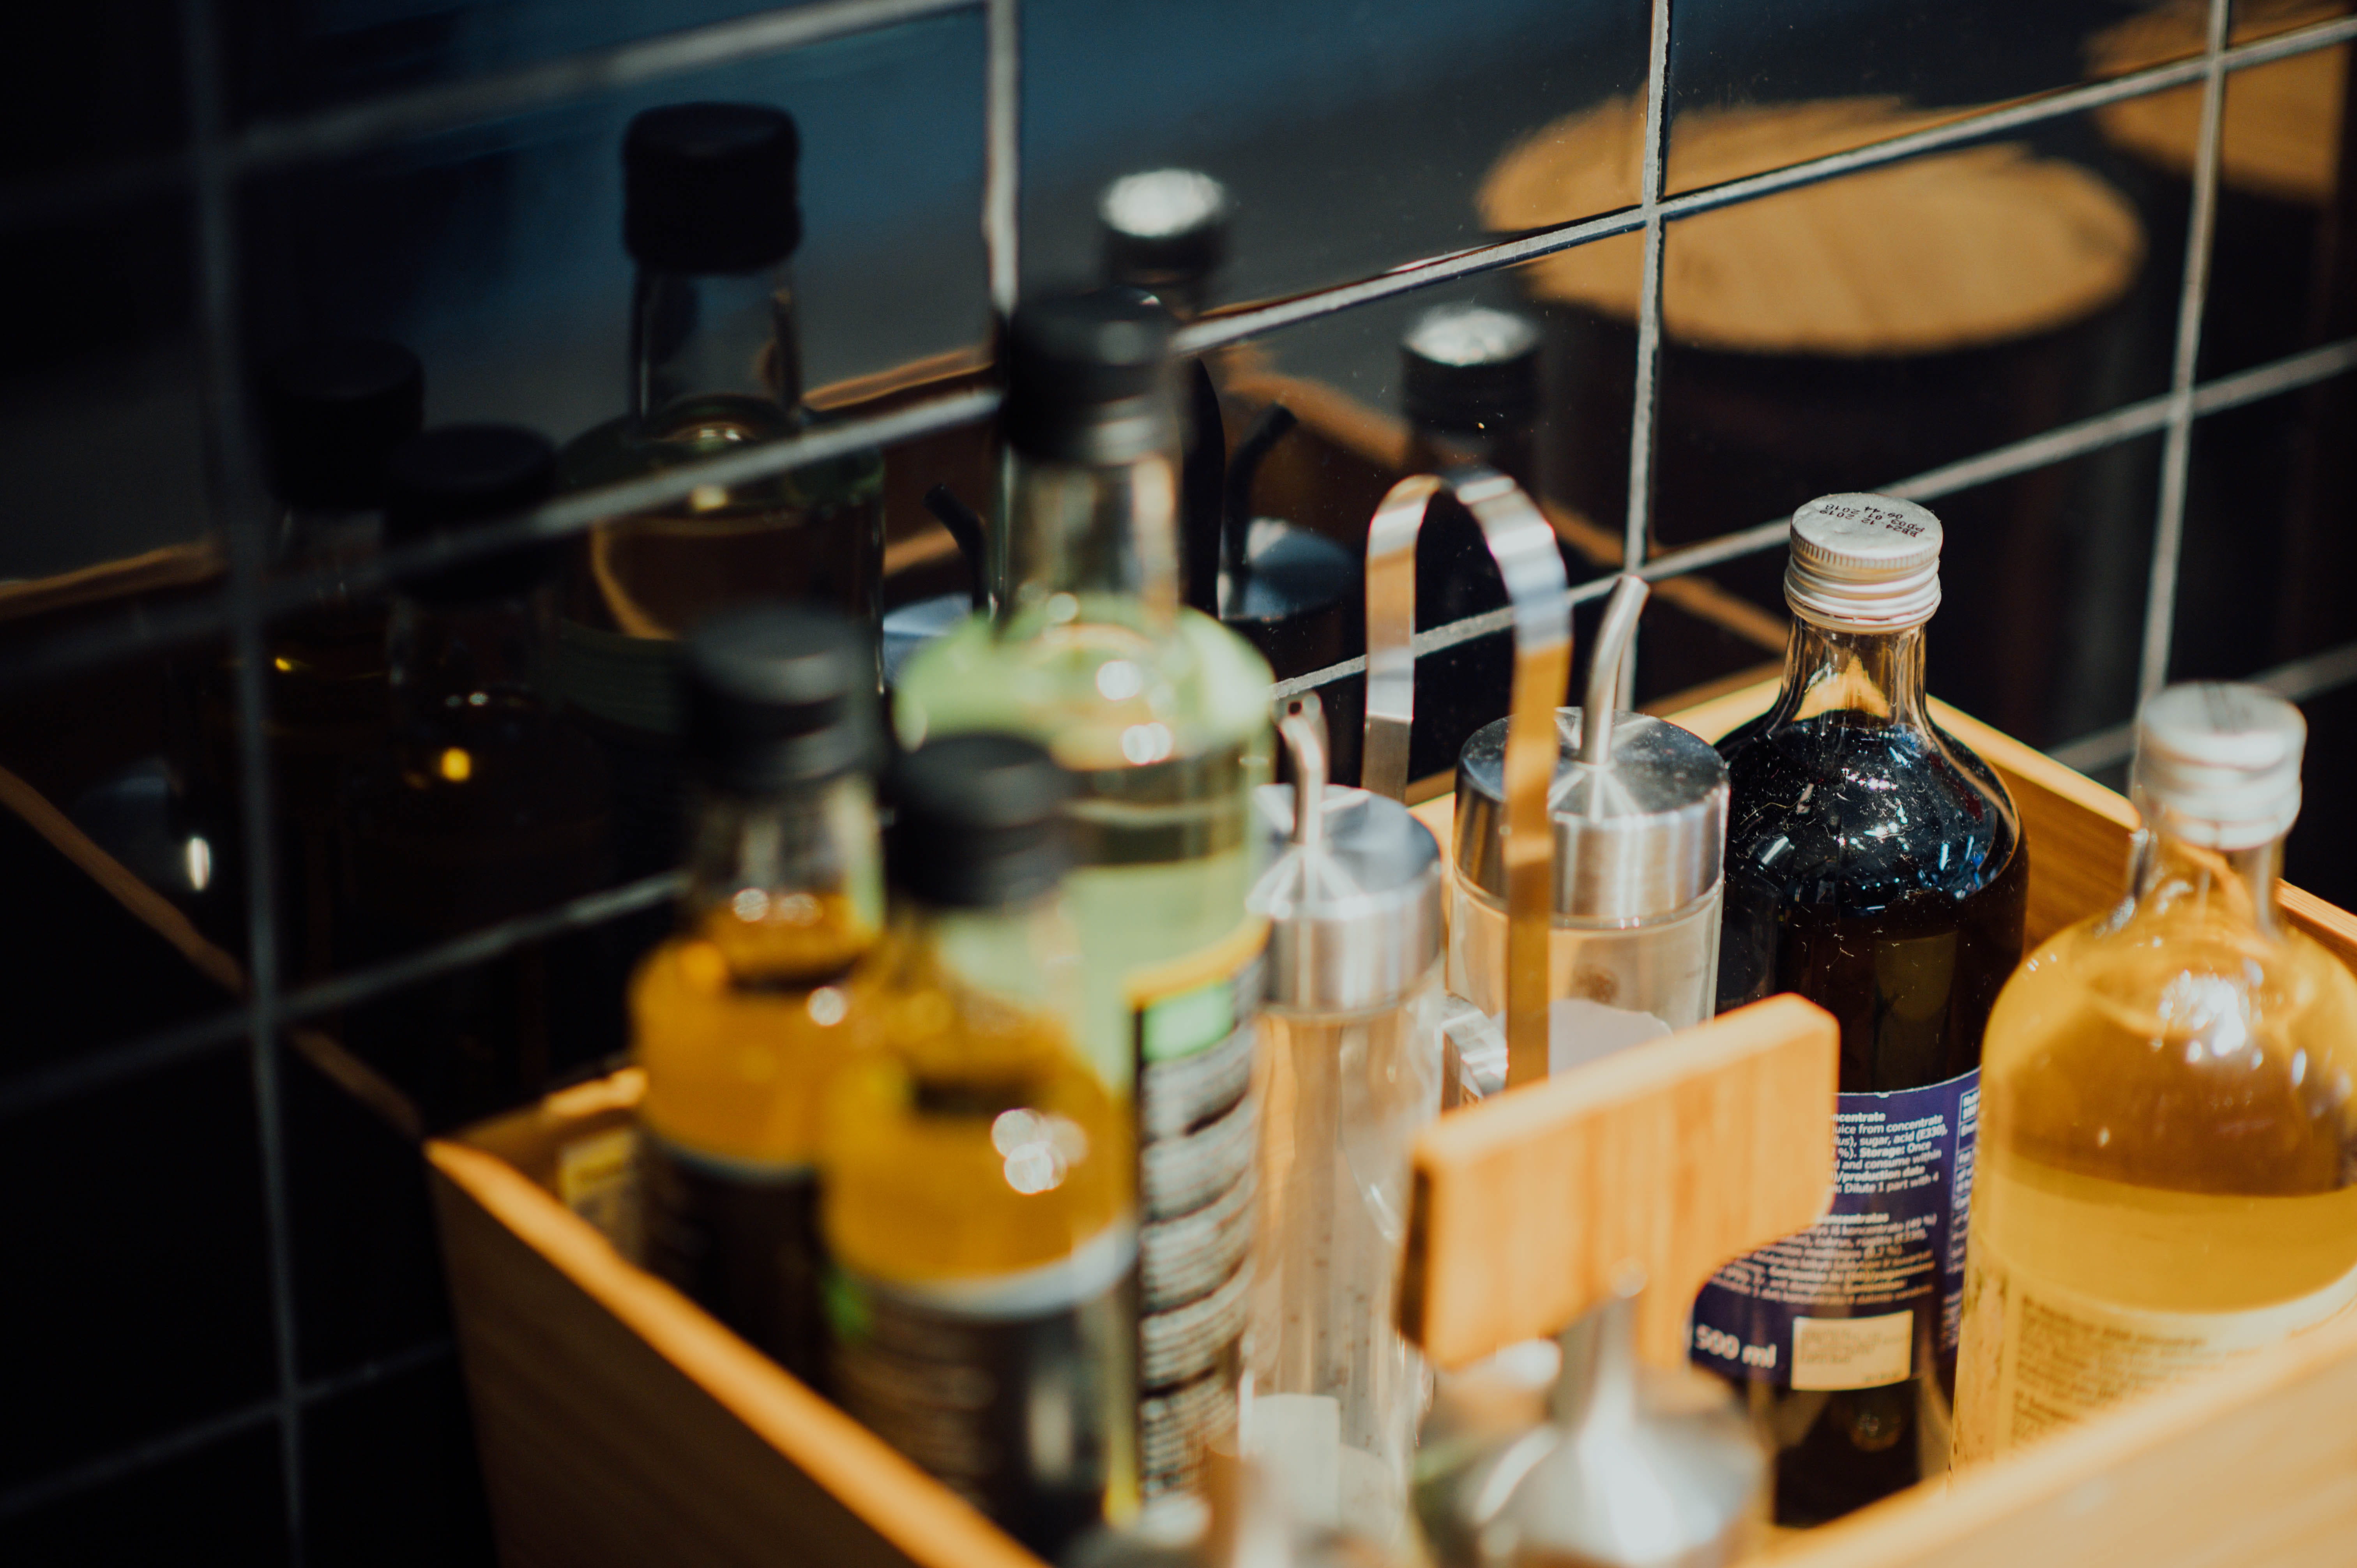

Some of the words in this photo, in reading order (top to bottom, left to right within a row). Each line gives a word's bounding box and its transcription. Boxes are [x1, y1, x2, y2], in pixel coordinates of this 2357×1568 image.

[1831, 1112, 1886, 1123] ncentrate
[1859, 1124, 1884, 1134] from
[1886, 1114, 1944, 1133] concentrate
[1859, 1136, 1891, 1147] sugar,
[1893, 1131, 1915, 1144] acid
[1915, 1123, 1948, 1142] (E330),
[1842, 1159, 1863, 1169] and
[1864, 1157, 1911, 1169] consume
[1912, 1149, 1942, 1164] within
[1859, 1146, 1905, 1158] Storage:
[1907, 1141, 1932, 1154] Once
[1902, 1165, 1926, 1178] date
[1844, 1183, 1876, 1194] Dilute
[1878, 1181, 1884, 1192] 1
[1886, 1180, 1908, 1193] part
[1909, 1174, 1931, 1188] with
[1932, 1171, 1939, 1182] 4
[1822, 1212, 1890, 1225] oncentratas
[1696, 1324, 1740, 1360] 500
[1742, 1344, 1777, 1368] ml
